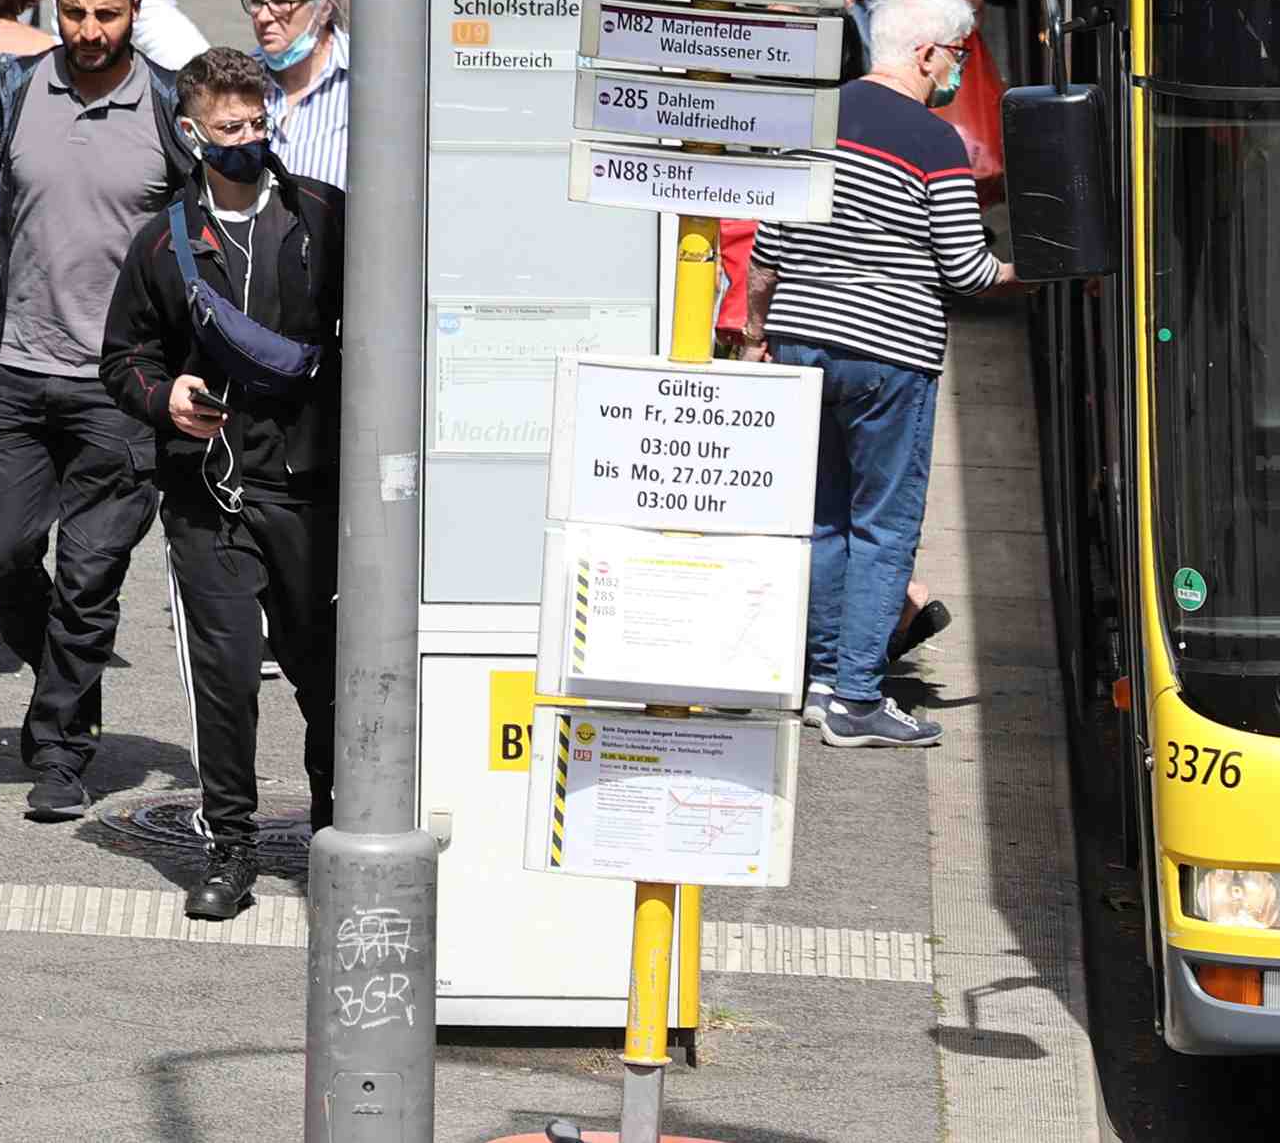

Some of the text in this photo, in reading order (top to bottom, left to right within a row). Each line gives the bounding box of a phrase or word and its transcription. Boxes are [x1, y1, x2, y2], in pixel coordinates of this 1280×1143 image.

[617, 12, 653, 34] M82
[661, 19, 751, 41] Marienfelde
[455, 51, 552, 68] Tarifbereich
[660, 37, 791, 62] Waldsassener Str.
[612, 87, 648, 109] 285
[658, 91, 715, 110] Dahlem
[657, 110, 756, 132] Waldfriedhof
[608, 159, 648, 182] N88
[653, 164, 694, 180] S-Bhf
[651, 183, 775, 206] Lichterfelde Süd
[658, 379, 720, 402] Gültig:
[600, 405, 775, 427] von Fr, 29.06.2020
[447, 420, 549, 442] Nachtlin
[640, 438, 730, 459] 03:00 Uhr
[593, 459, 773, 487] bis Mo, 27.07.2020
[637, 491, 727, 512] 03:00 Uhr
[1184, 571, 1194, 589] 4
[1167, 741, 1242, 788] 3376
